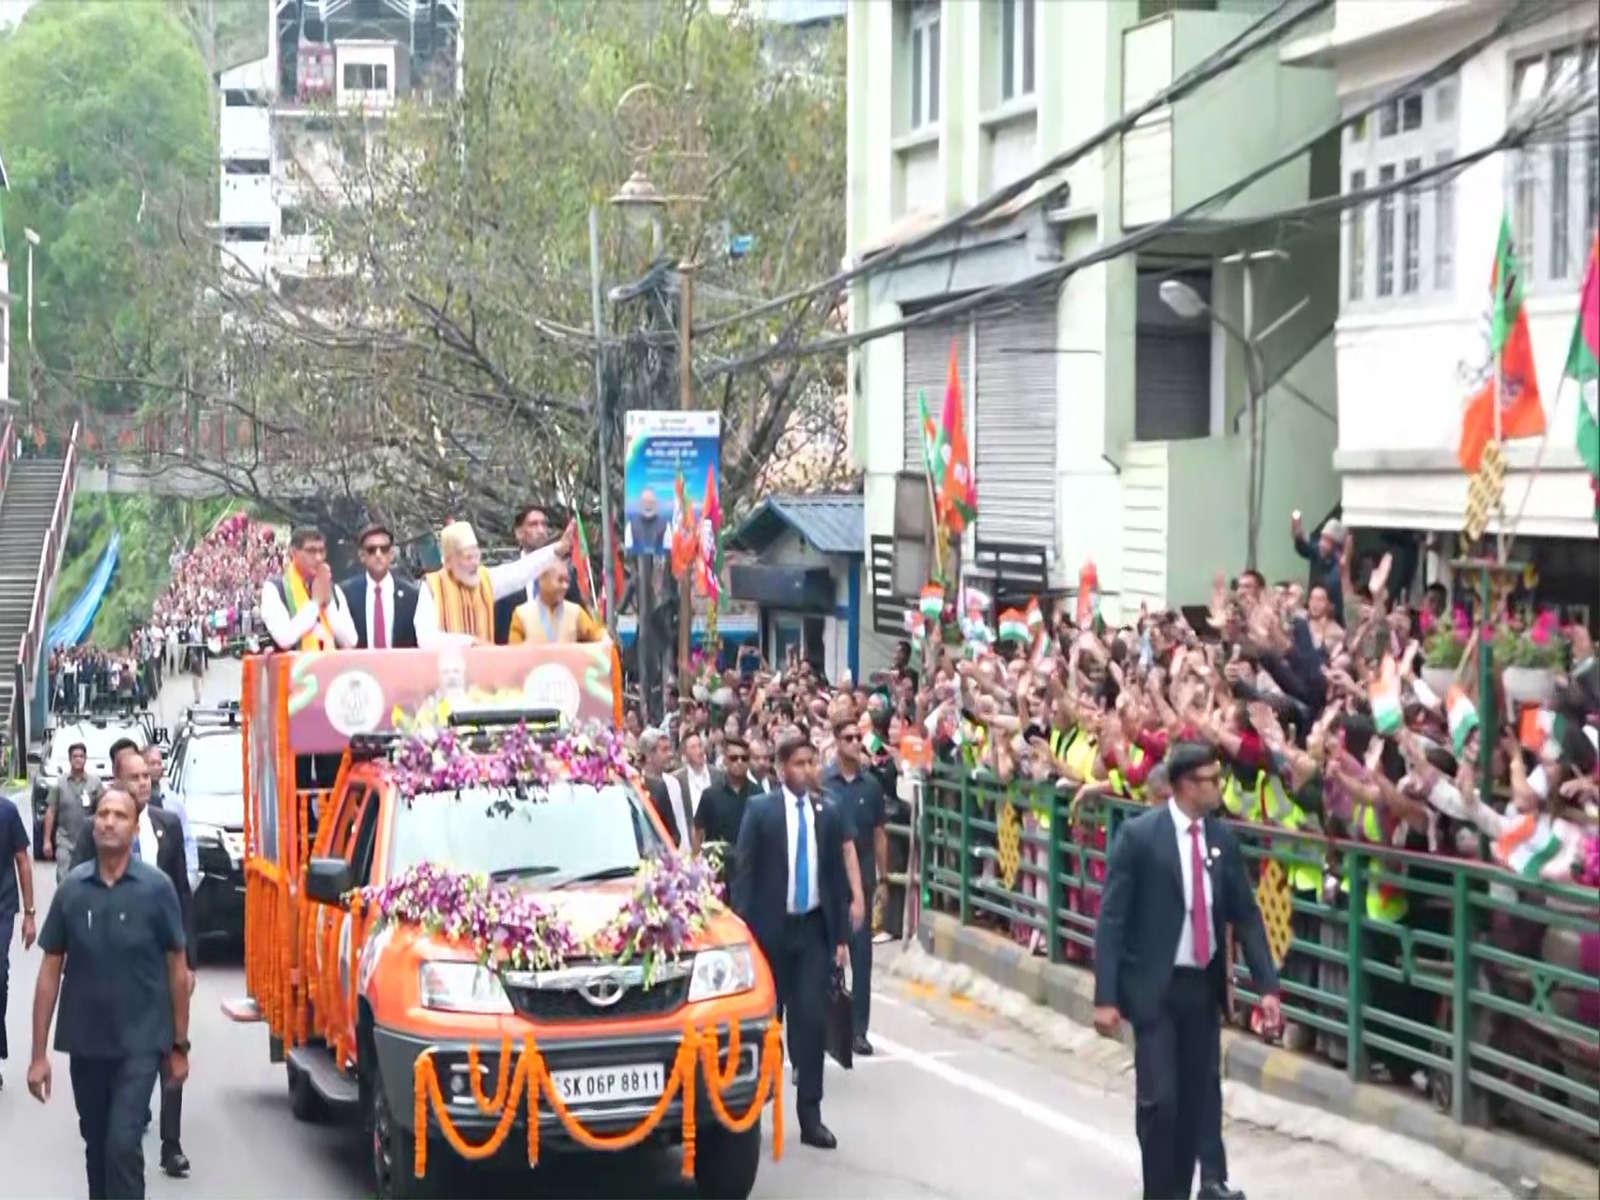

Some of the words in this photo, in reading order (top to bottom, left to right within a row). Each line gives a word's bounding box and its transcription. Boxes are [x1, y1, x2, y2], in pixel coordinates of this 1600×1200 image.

[564, 1077, 581, 1098] SK
[586, 1074, 615, 1094] 06P
[621, 1071, 659, 1092] 8811
